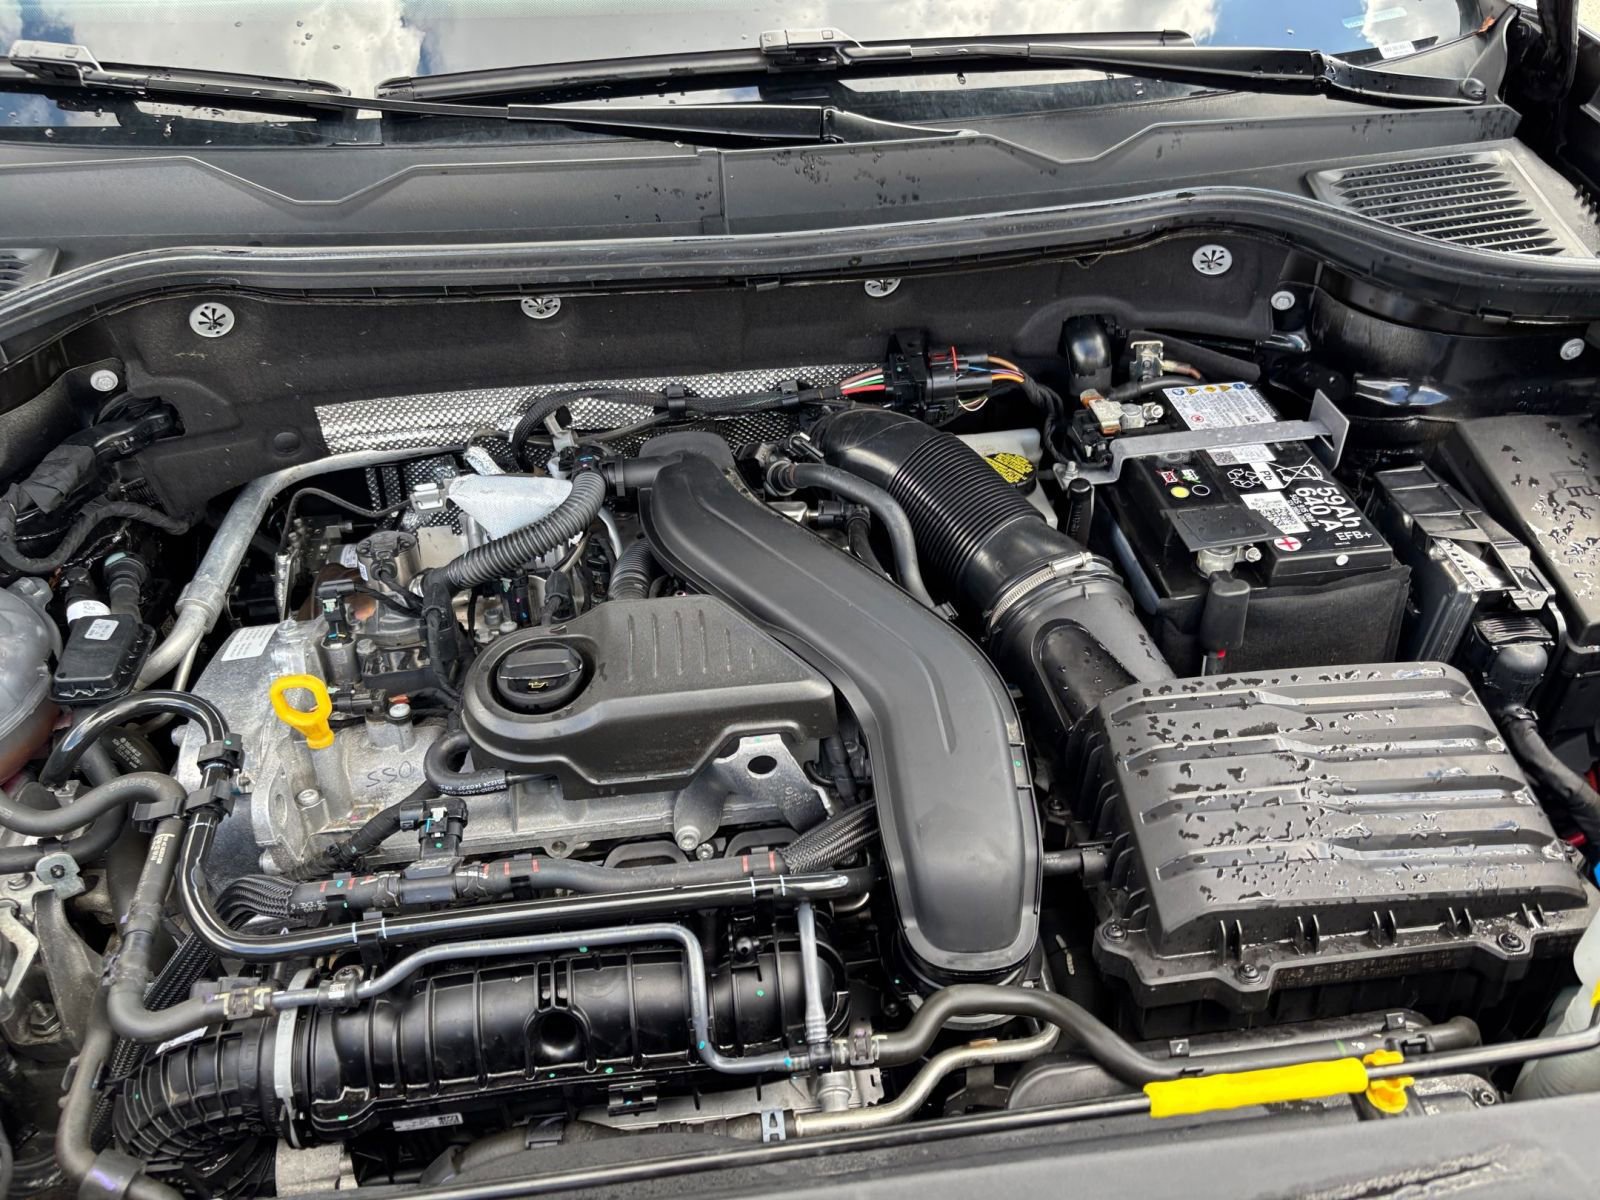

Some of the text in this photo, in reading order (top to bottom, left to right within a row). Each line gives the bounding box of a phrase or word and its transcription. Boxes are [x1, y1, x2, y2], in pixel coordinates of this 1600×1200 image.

[1259, 470, 1272, 481] Pb
[1294, 487, 1332, 516] 640
[1318, 519, 1344, 532] A
[1315, 486, 1362, 528] 59Ah
[1335, 530, 1373, 541] EFB+
